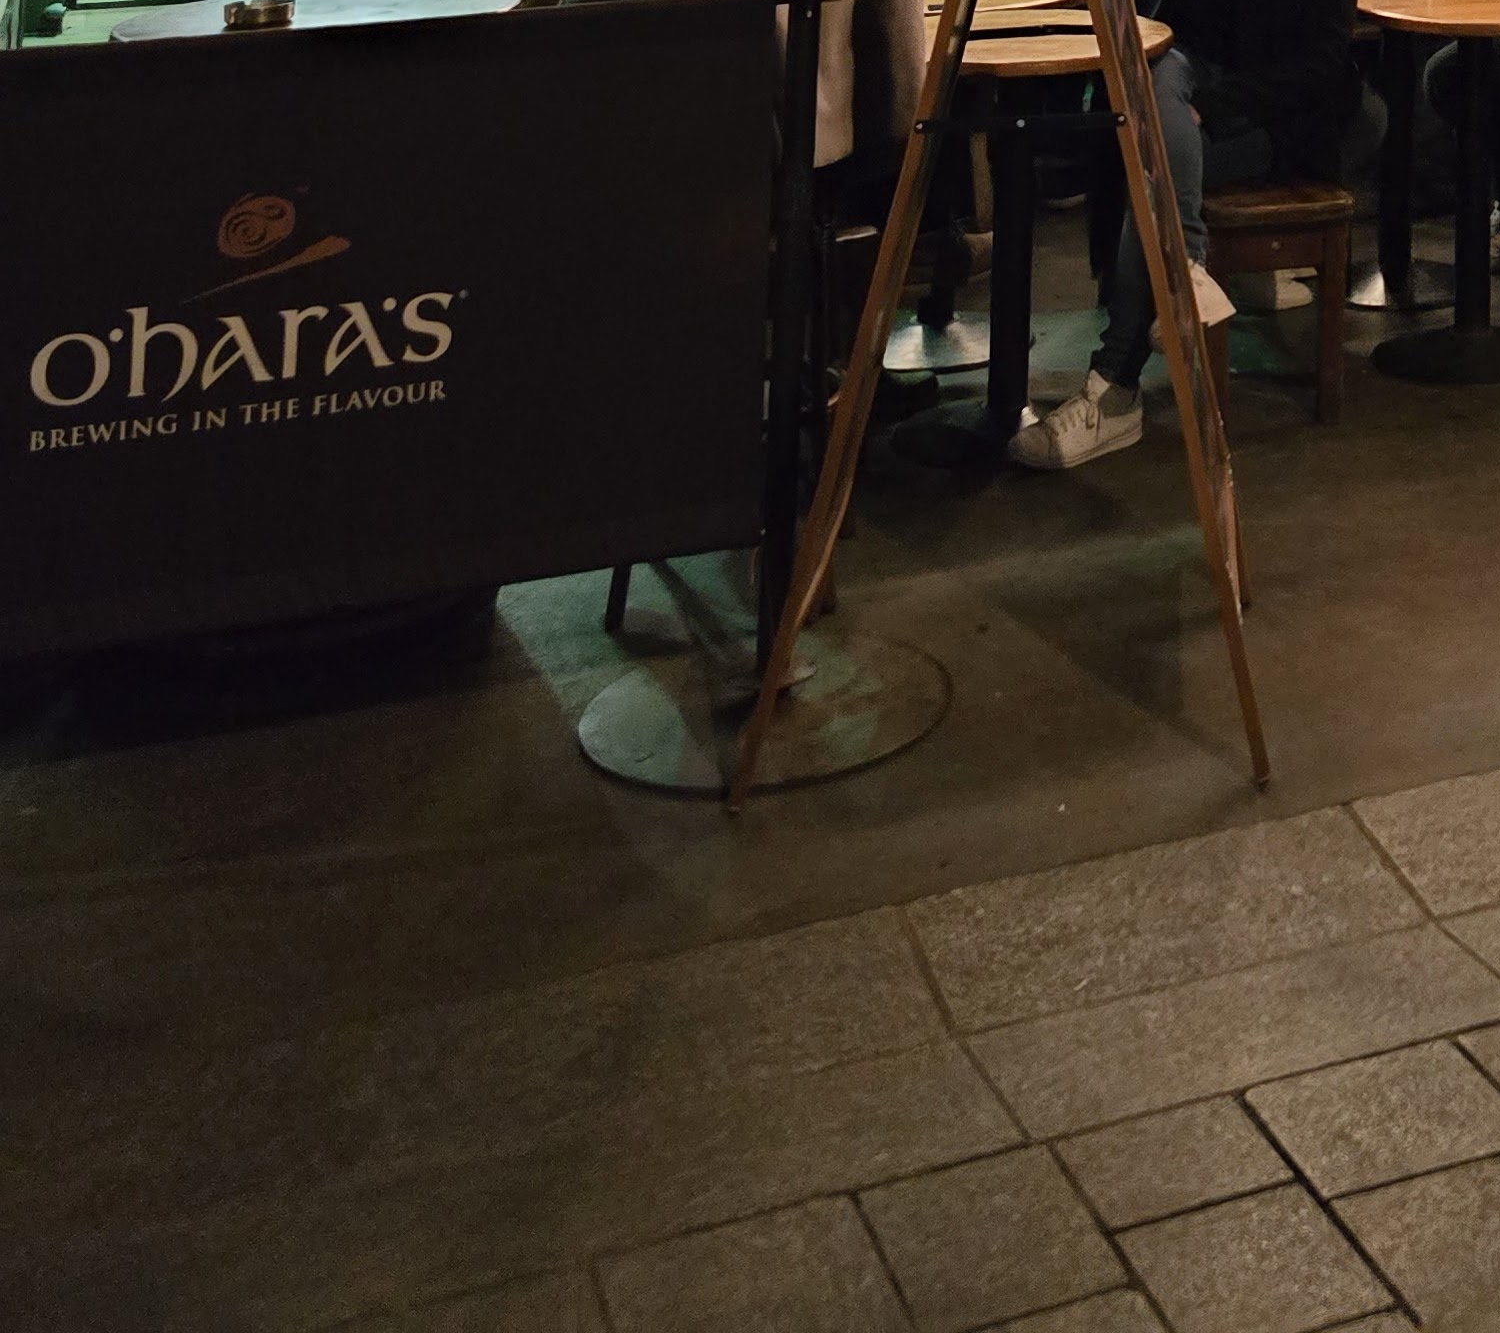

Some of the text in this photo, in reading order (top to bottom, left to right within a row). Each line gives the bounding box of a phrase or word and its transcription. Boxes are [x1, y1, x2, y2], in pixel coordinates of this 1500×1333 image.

[28, 378, 447, 453] BREWING IN THE FLAVOUR
